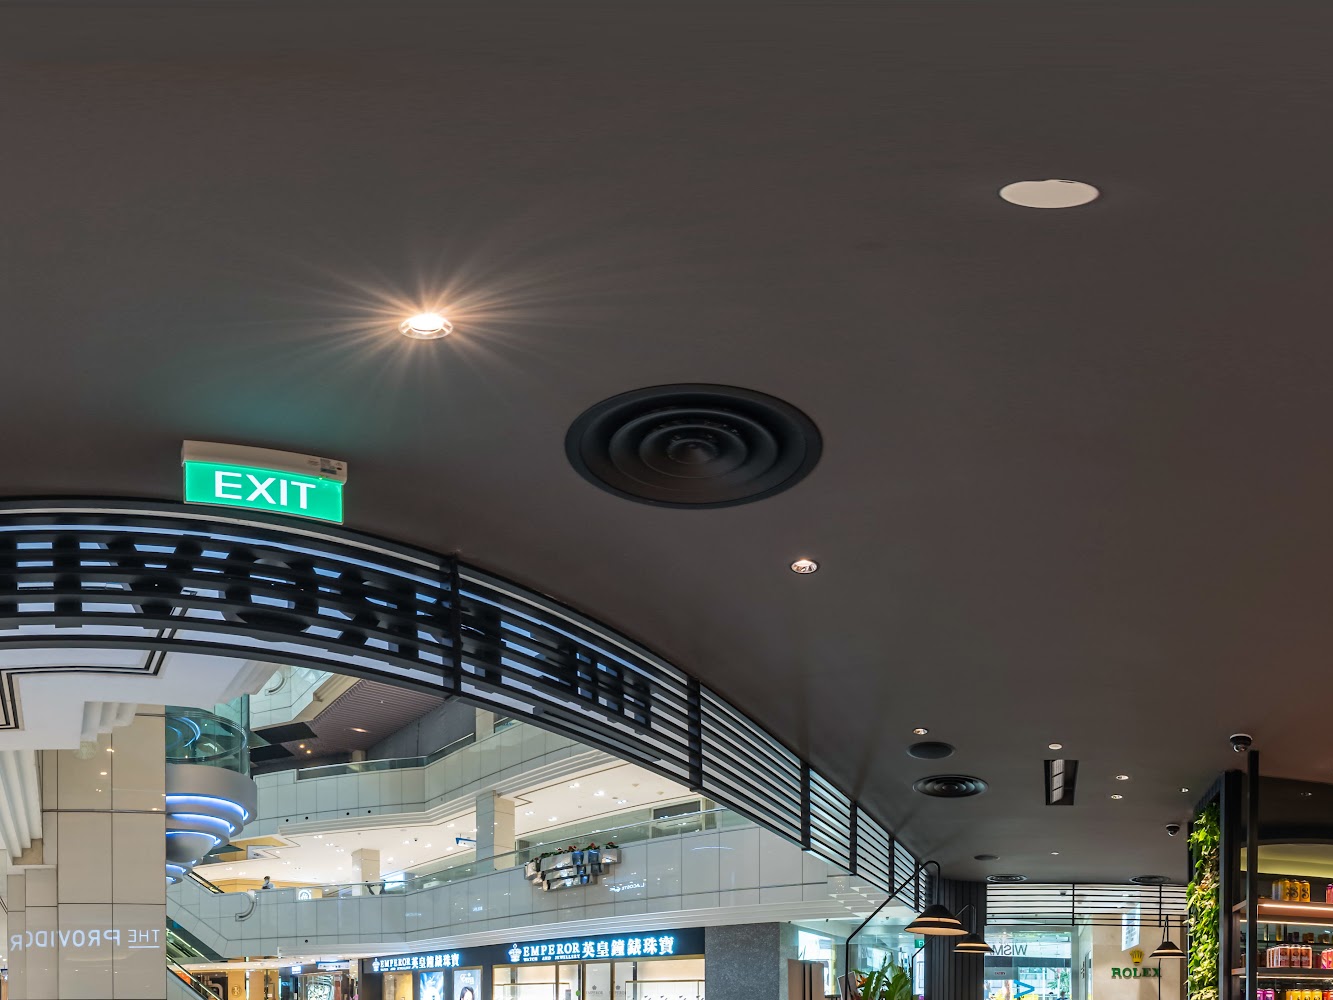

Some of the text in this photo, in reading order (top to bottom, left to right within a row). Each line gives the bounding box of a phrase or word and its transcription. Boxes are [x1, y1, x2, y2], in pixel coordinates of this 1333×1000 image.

[214, 470, 316, 510] EXIT
[523, 942, 580, 957] EMPEROR
[380, 957, 411, 968] EMPEROR
[1111, 967, 1162, 978] ROLEX
